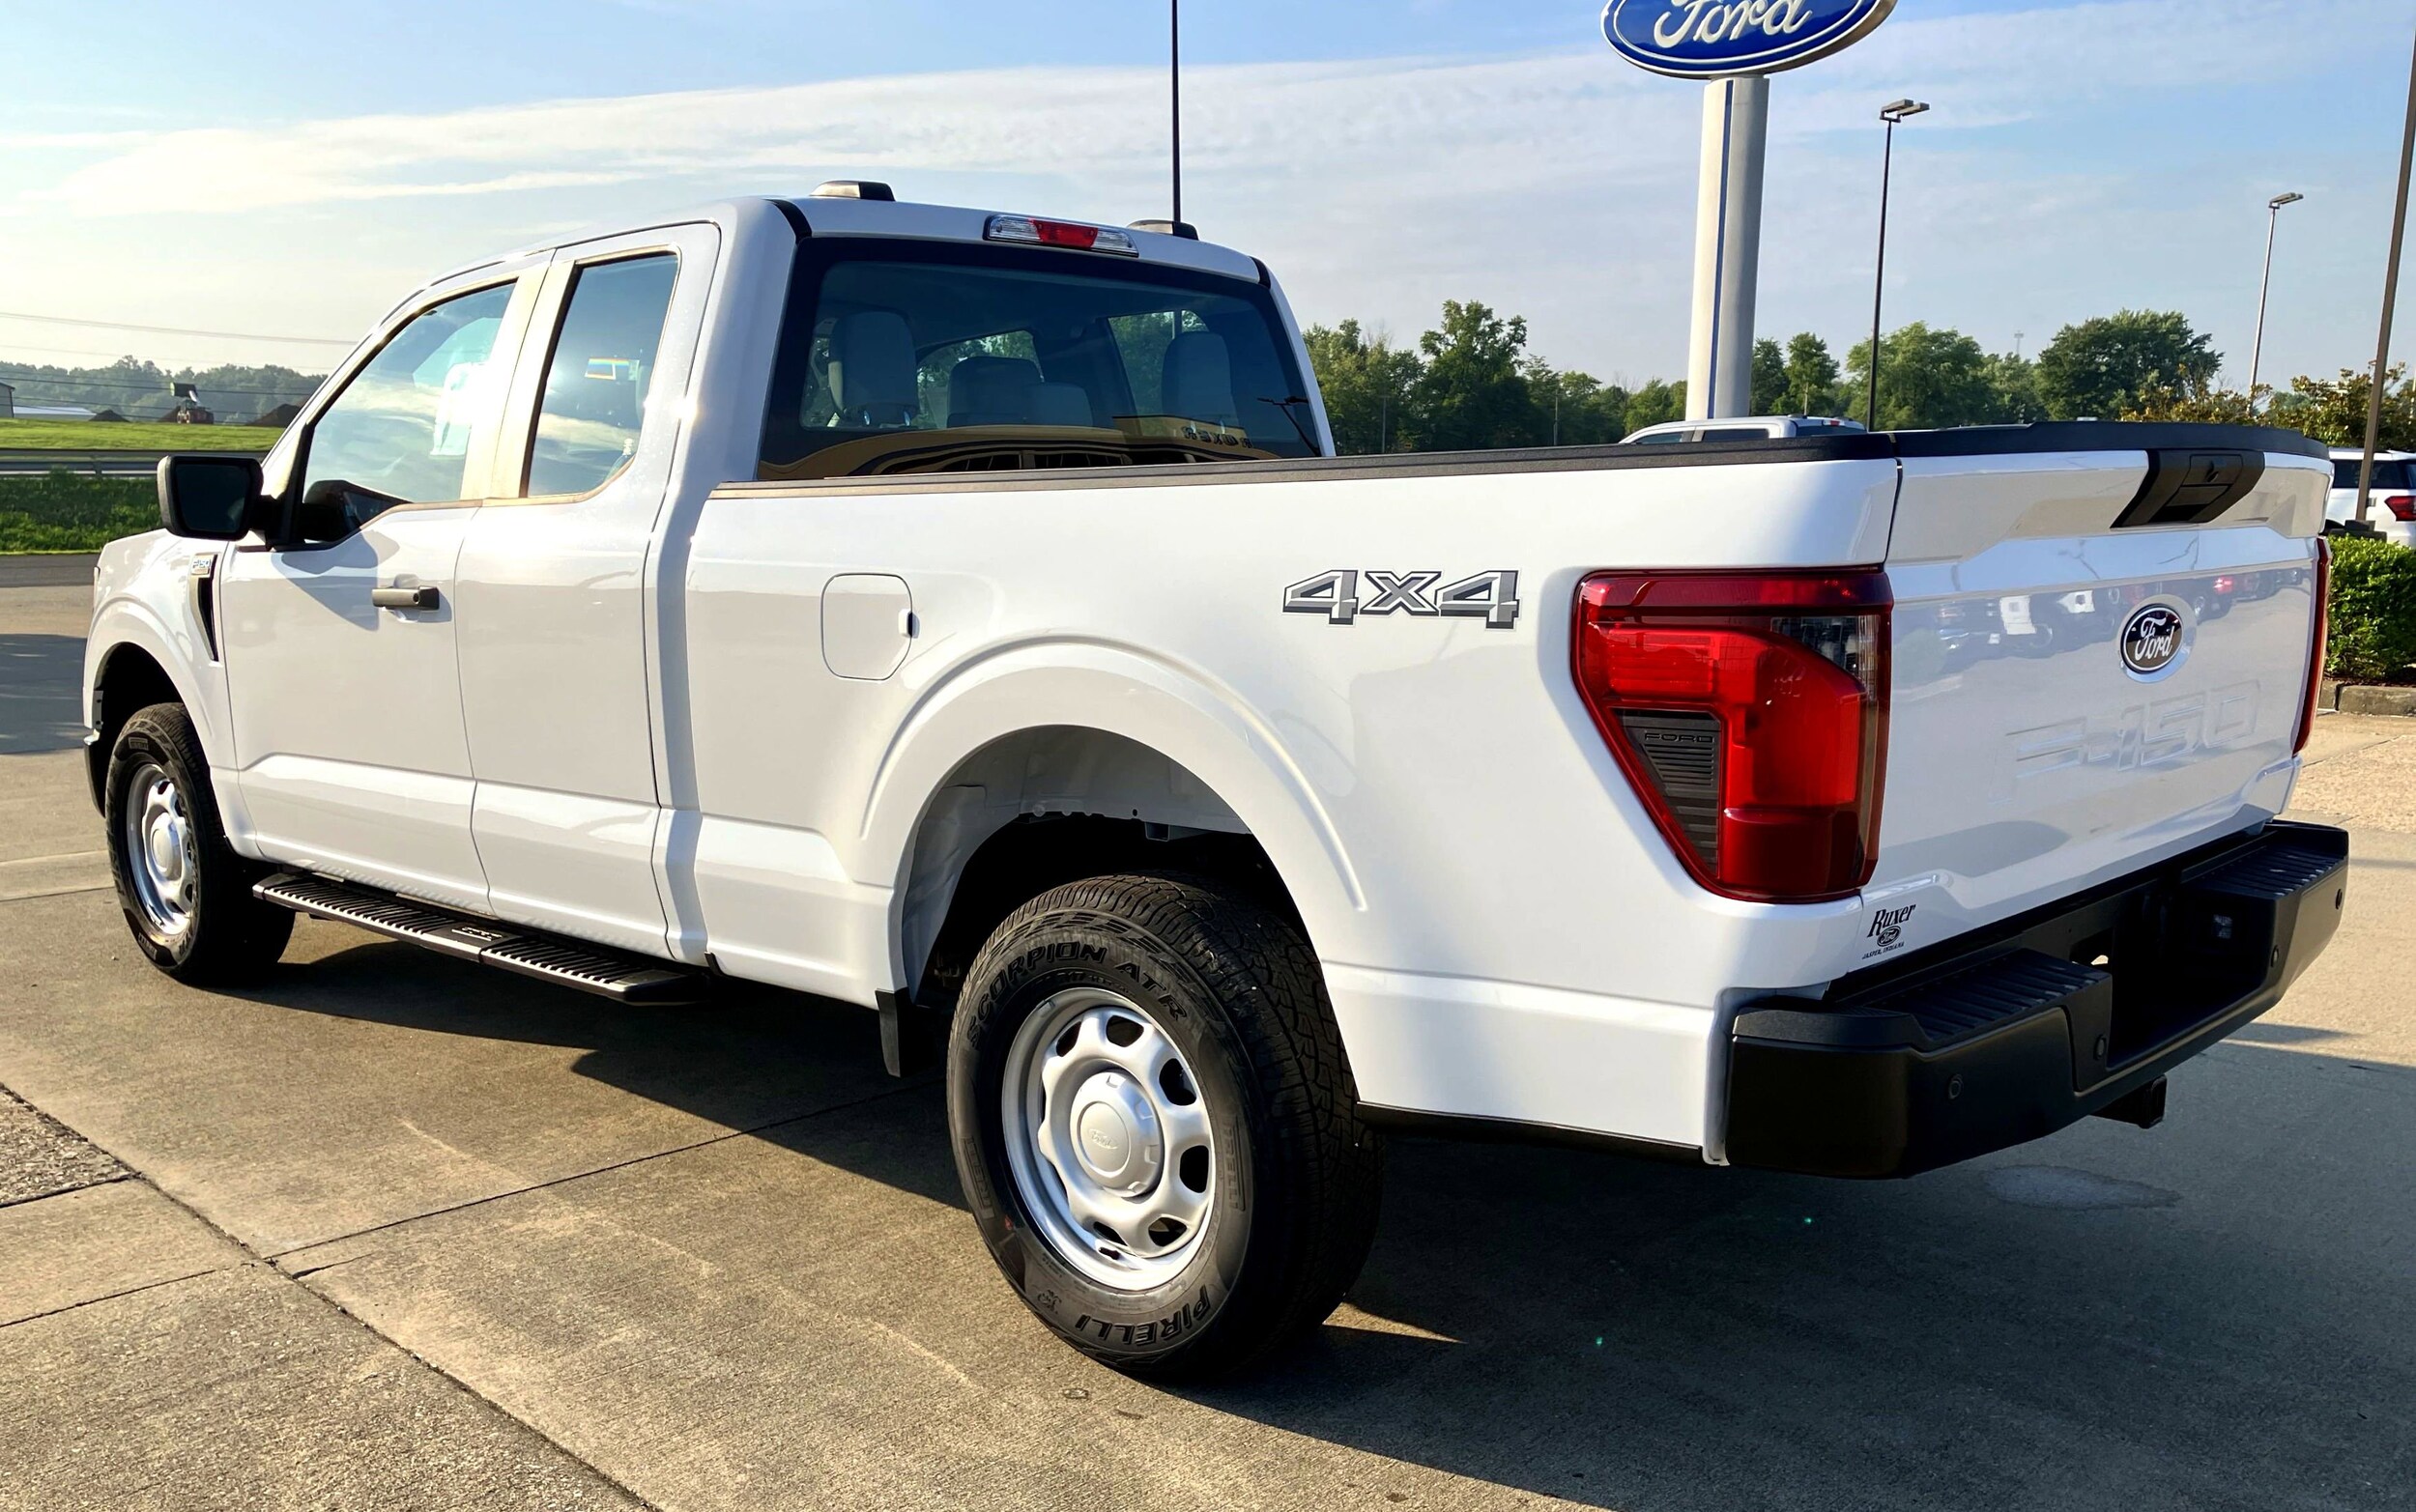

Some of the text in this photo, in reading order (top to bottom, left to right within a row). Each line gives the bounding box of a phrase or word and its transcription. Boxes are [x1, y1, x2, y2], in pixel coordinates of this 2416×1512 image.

[1654, 0, 1813, 48] Ford
[2134, 615, 2175, 661] Ford
[1644, 732, 1715, 743] FORD
[1866, 904, 1916, 938] Ruxer
[966, 941, 1188, 1050] SCORPION ATR
[1074, 1284, 1212, 1347] PIRELLI
